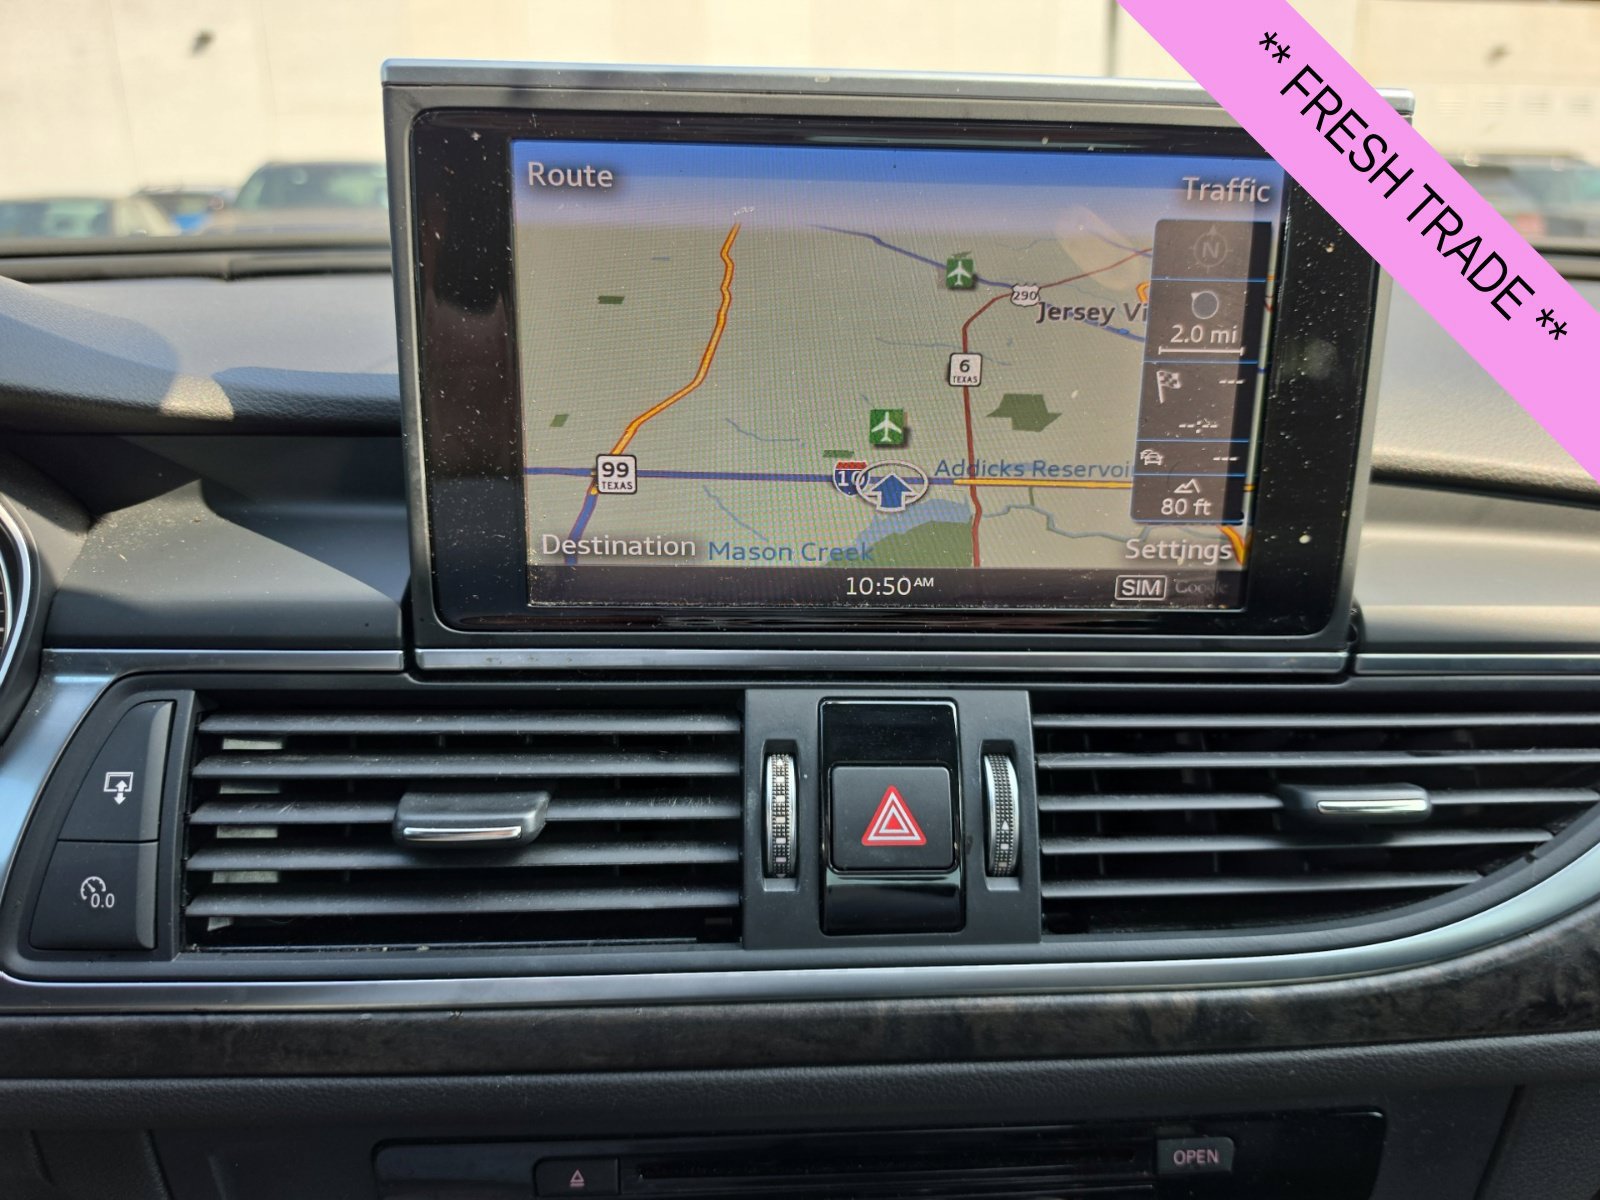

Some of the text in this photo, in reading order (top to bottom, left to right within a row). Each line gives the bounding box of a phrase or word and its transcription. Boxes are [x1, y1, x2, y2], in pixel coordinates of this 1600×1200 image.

[528, 161, 613, 188] Route
[1182, 176, 1271, 204] Traffic
[1013, 290, 1038, 301] 290
[1036, 302, 1116, 327] Jersey
[1170, 325, 1239, 344] 2.0 mi
[959, 359, 971, 373] 6
[952, 375, 979, 385] TEXAS
[601, 462, 631, 478] 99
[935, 459, 1025, 478] Addicks
[601, 481, 633, 491] TEXAS
[1161, 498, 1212, 516] 80 ft
[541, 534, 697, 557] Destination
[708, 542, 874, 562] Mason Creek
[1125, 538, 1233, 566] Settings
[1121, 579, 1161, 596] SIM
[90, 893, 115, 908] 0.0
[1173, 1149, 1219, 1164] OPEN
